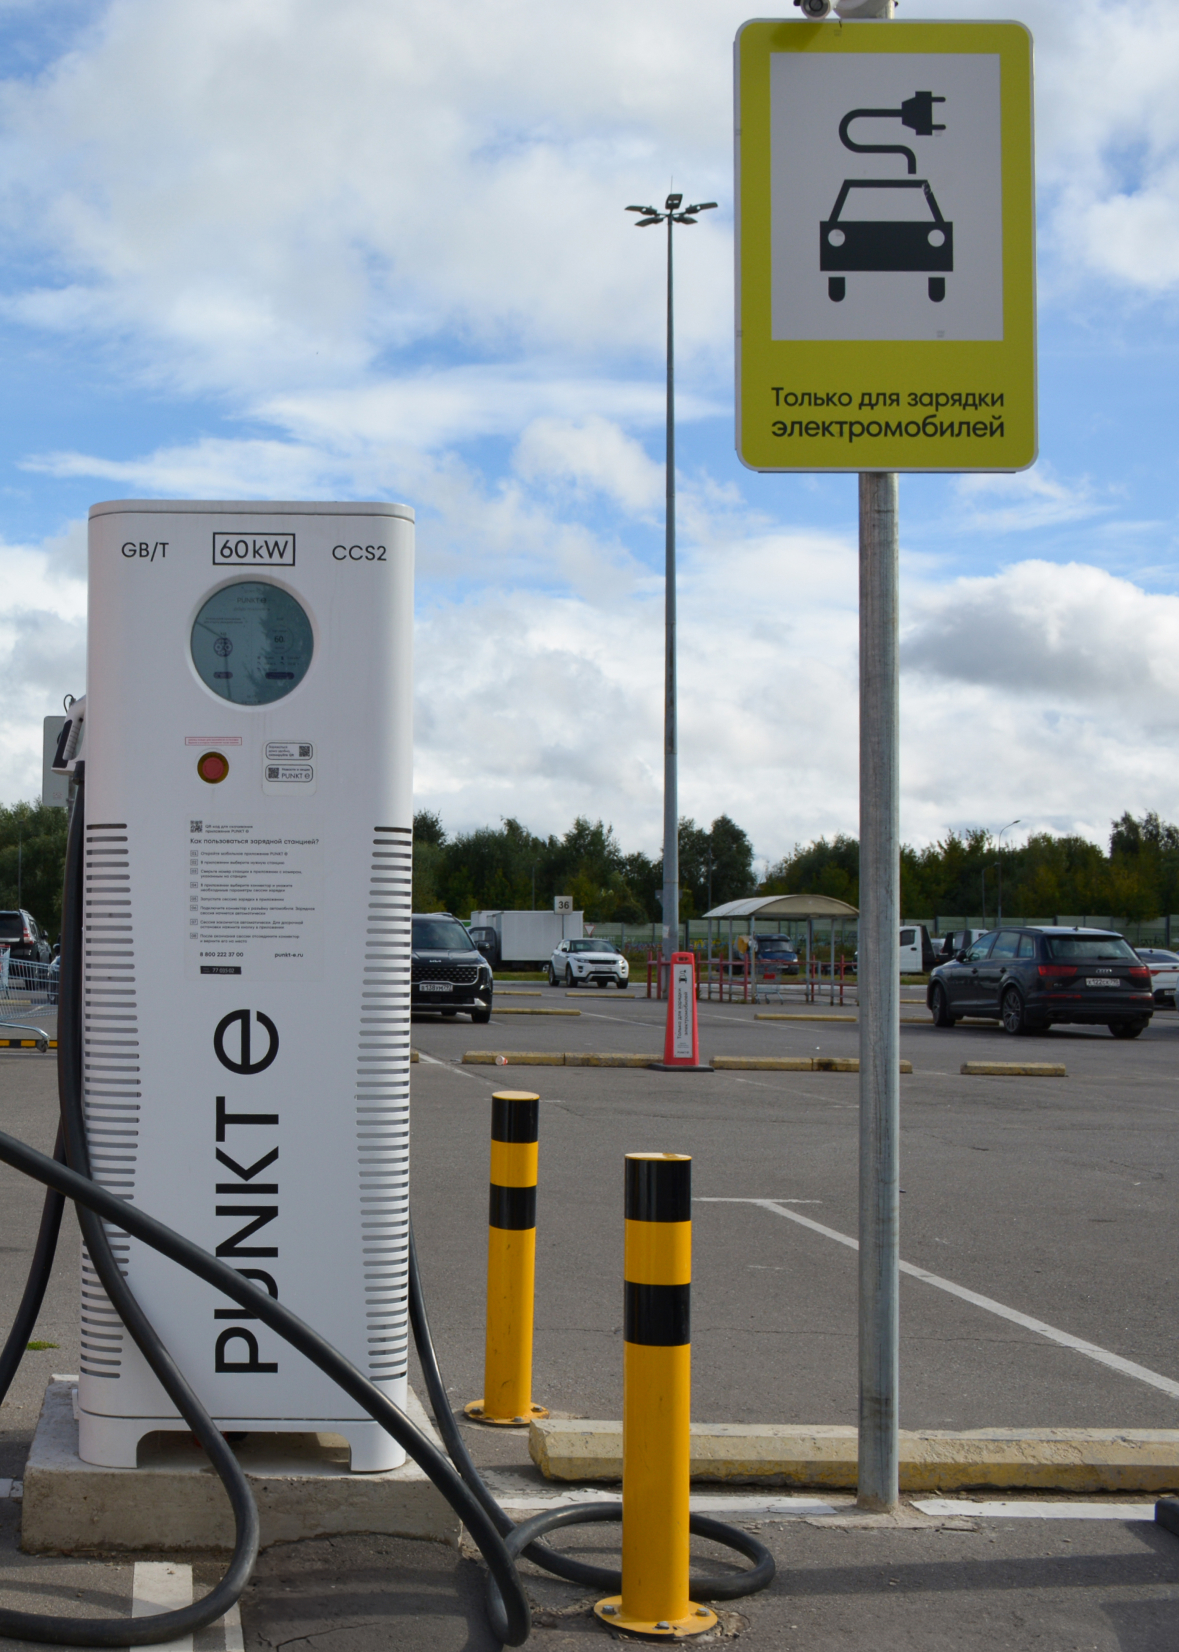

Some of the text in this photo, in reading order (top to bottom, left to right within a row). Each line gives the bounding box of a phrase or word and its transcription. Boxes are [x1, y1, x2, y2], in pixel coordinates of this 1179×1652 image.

[771, 387, 1004, 411] Только для зарядки
[772, 414, 1004, 443] электромобилей
[121, 542, 170, 562] GB/T
[332, 544, 387, 562] CCS2
[558, 900, 570, 910] 36
[214, 1096, 279, 1373] PUNKT
